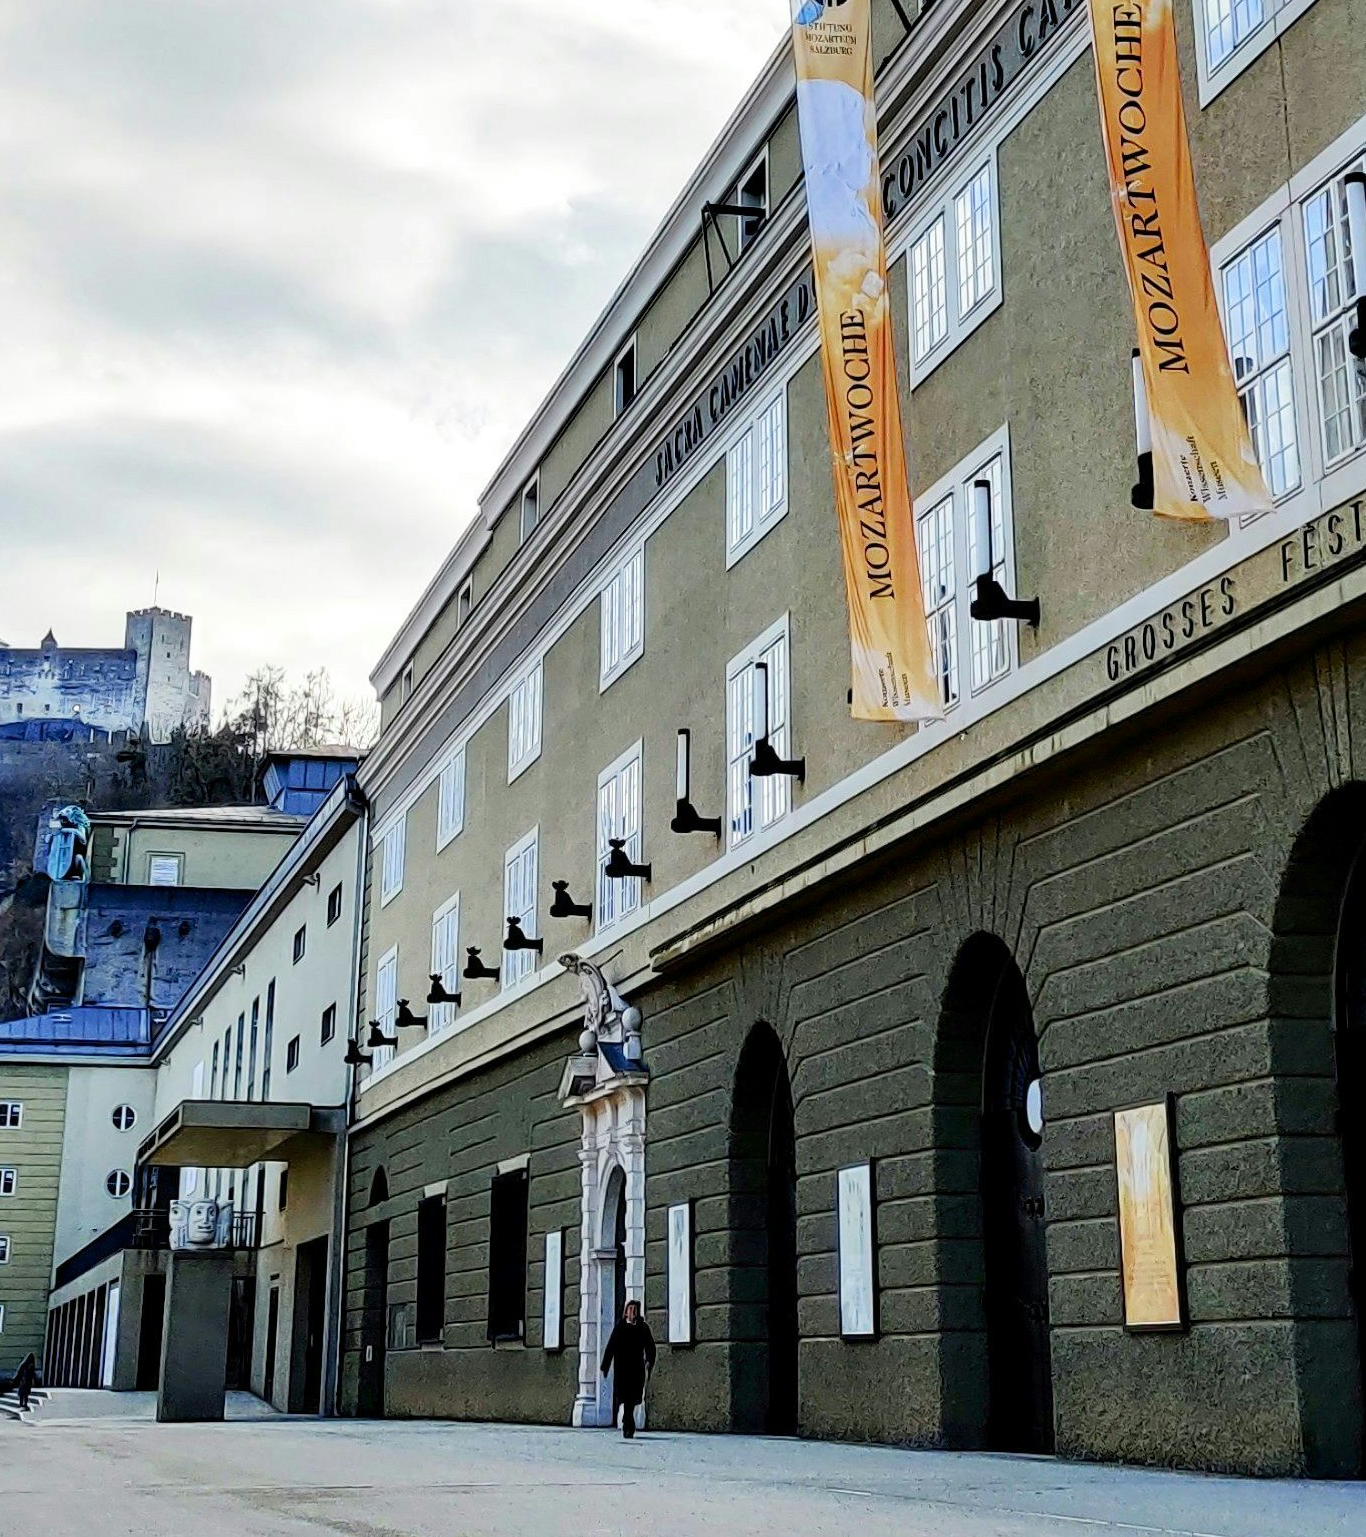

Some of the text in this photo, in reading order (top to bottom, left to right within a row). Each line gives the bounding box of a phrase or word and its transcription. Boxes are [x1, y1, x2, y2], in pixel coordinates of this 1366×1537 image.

[709, 300, 790, 422] CAMENAE
[883, 45, 1004, 219] CONCITIS
[1019, 0, 1072, 58] CA
[1112, 3, 1190, 375] MOZARTWOCHE
[839, 308, 895, 601] MOZARTWOCHE
[1107, 500, 1364, 681] GROSSES FEST
